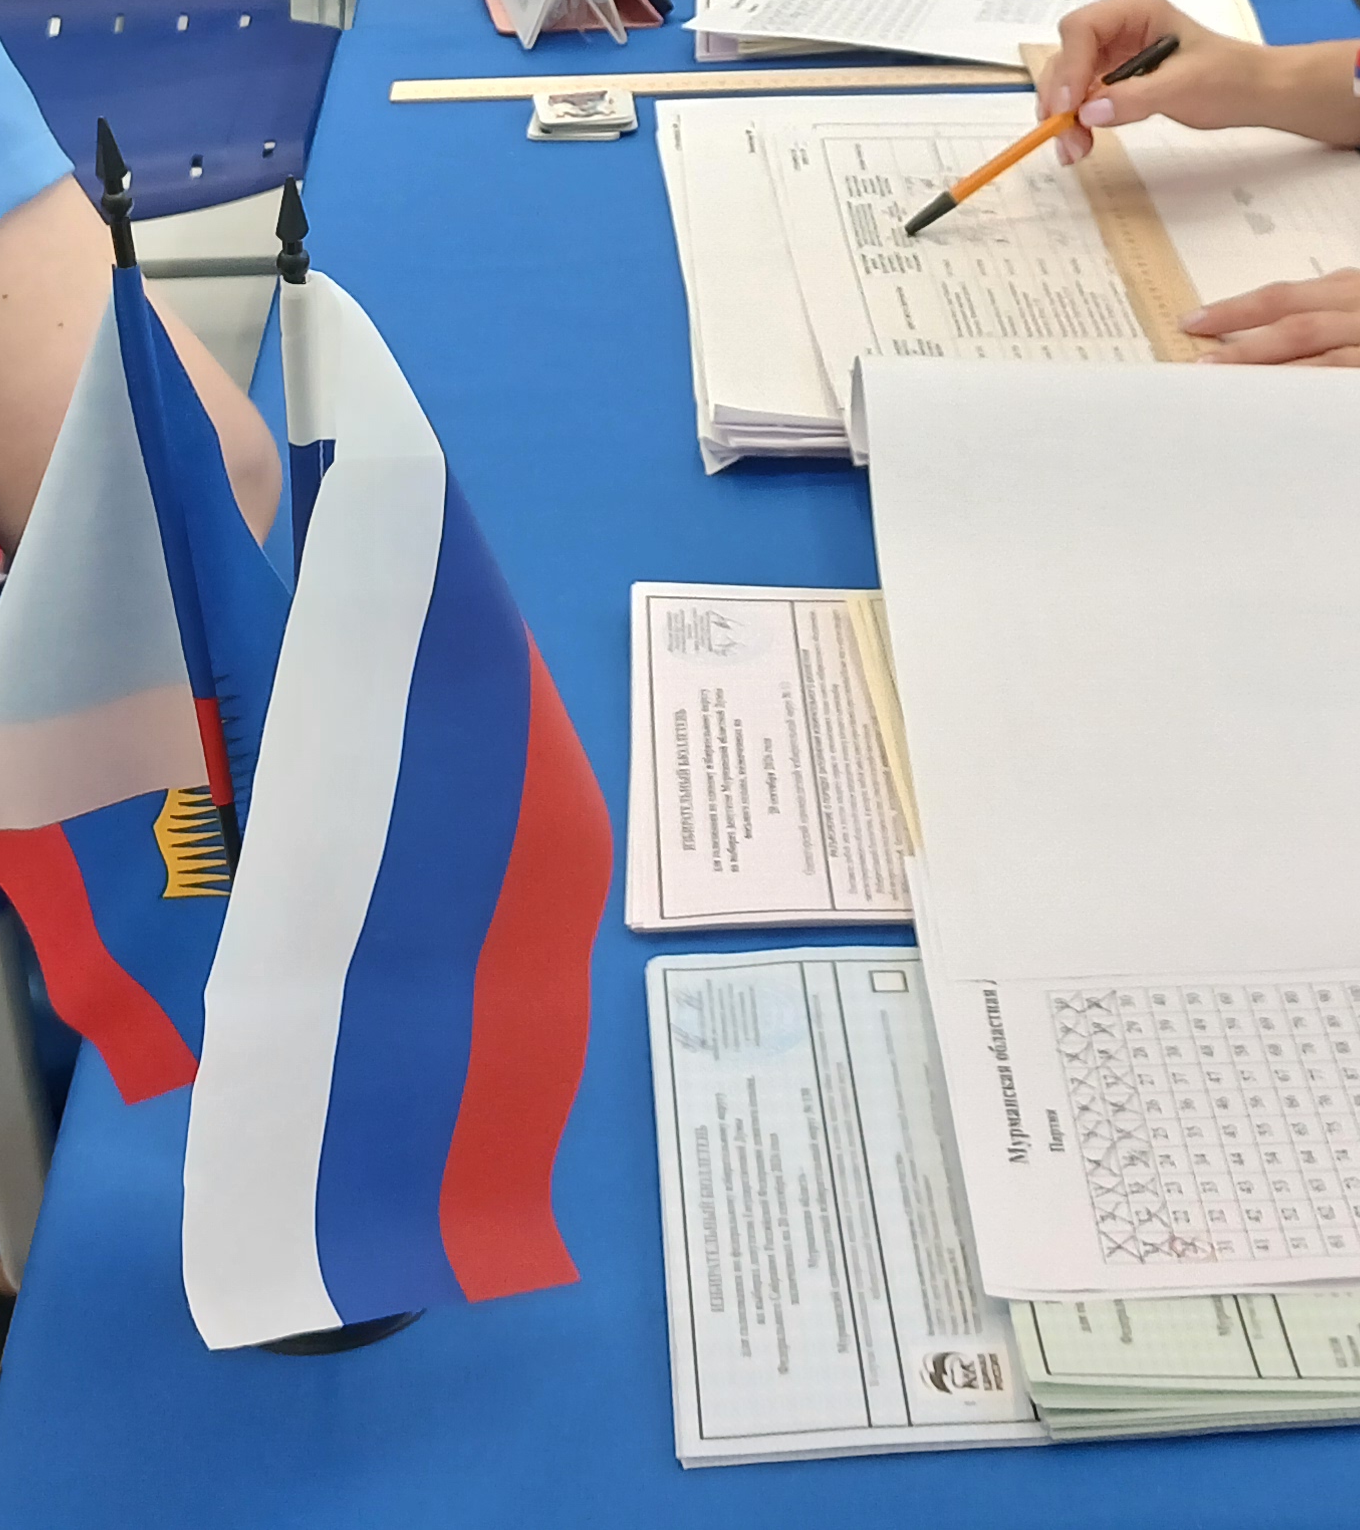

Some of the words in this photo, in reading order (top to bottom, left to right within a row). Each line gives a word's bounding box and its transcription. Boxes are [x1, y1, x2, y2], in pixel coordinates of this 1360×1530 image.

[983, 989, 1010, 1062] областная
[997, 1065, 1032, 1164] Мурманская
[1045, 1108, 1066, 1153] Партия
